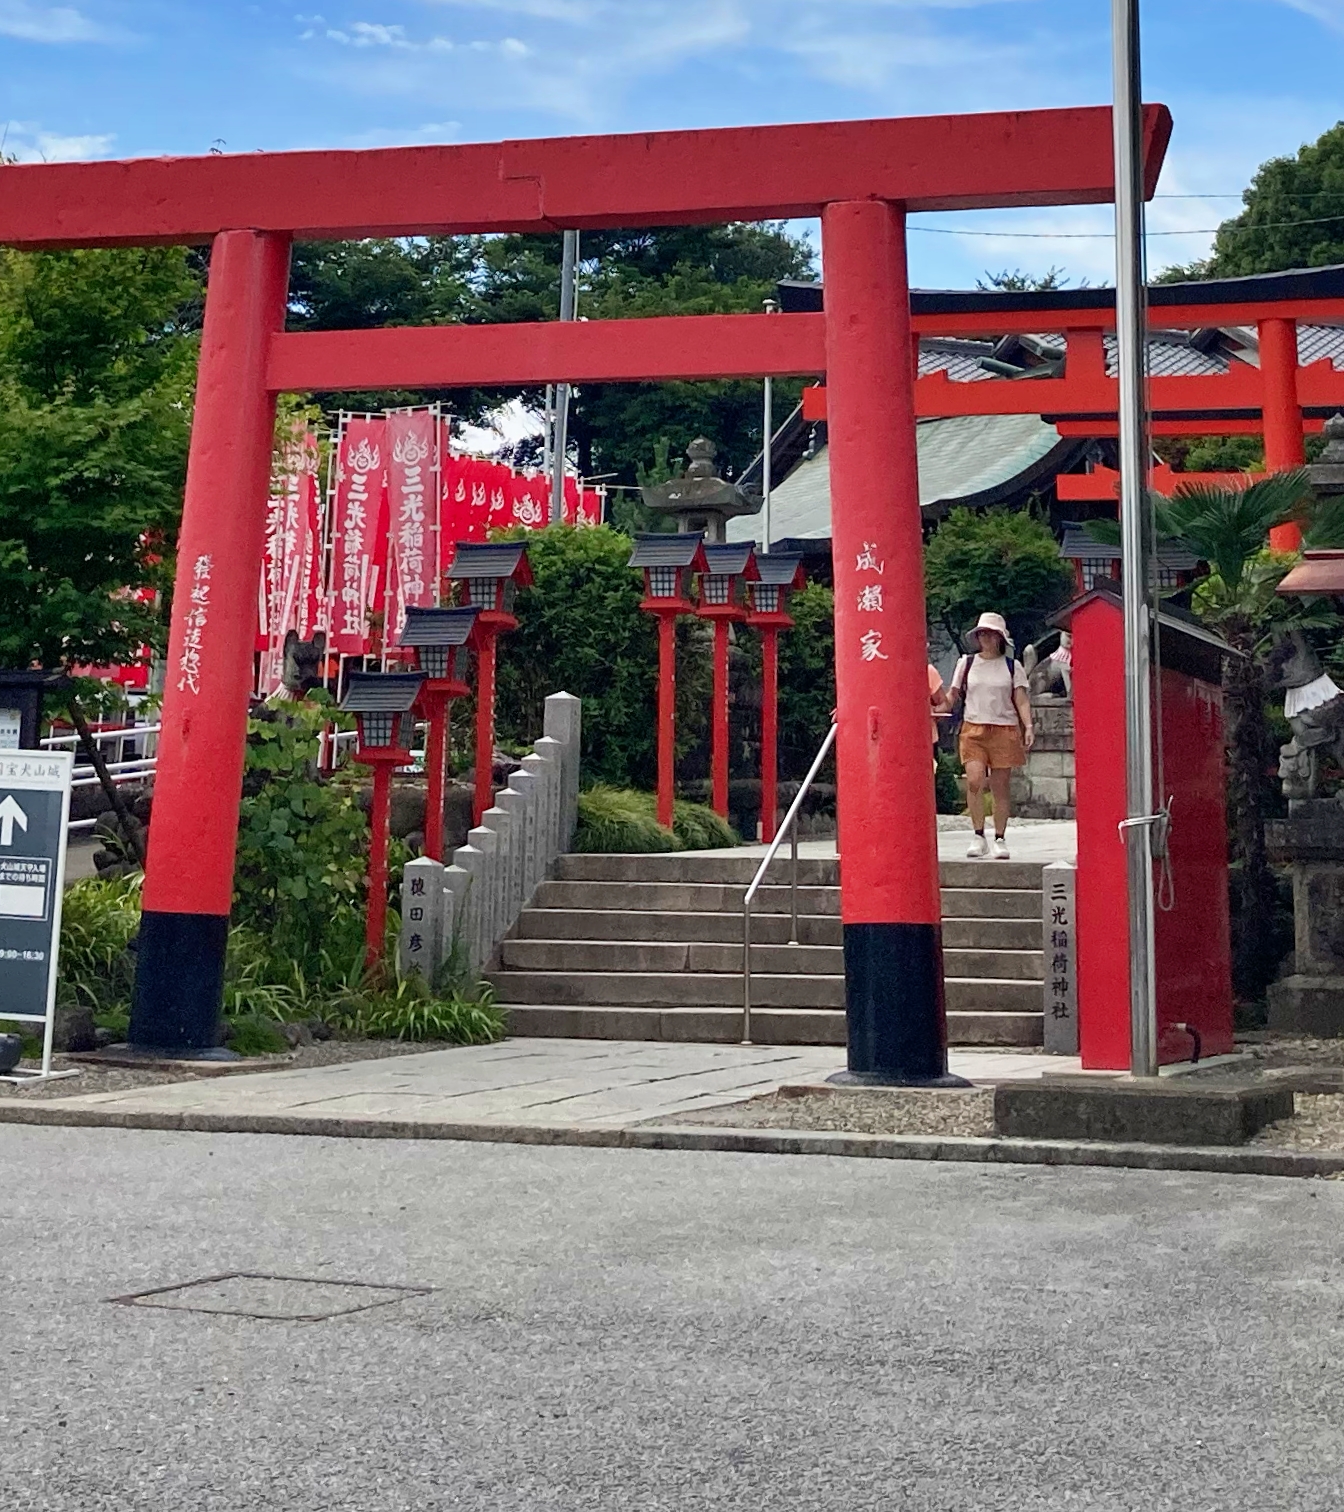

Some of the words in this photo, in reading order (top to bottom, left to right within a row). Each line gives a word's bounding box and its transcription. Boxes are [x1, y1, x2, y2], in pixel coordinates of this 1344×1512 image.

[1051, 883, 1069, 1020] 三光稲荷神社
